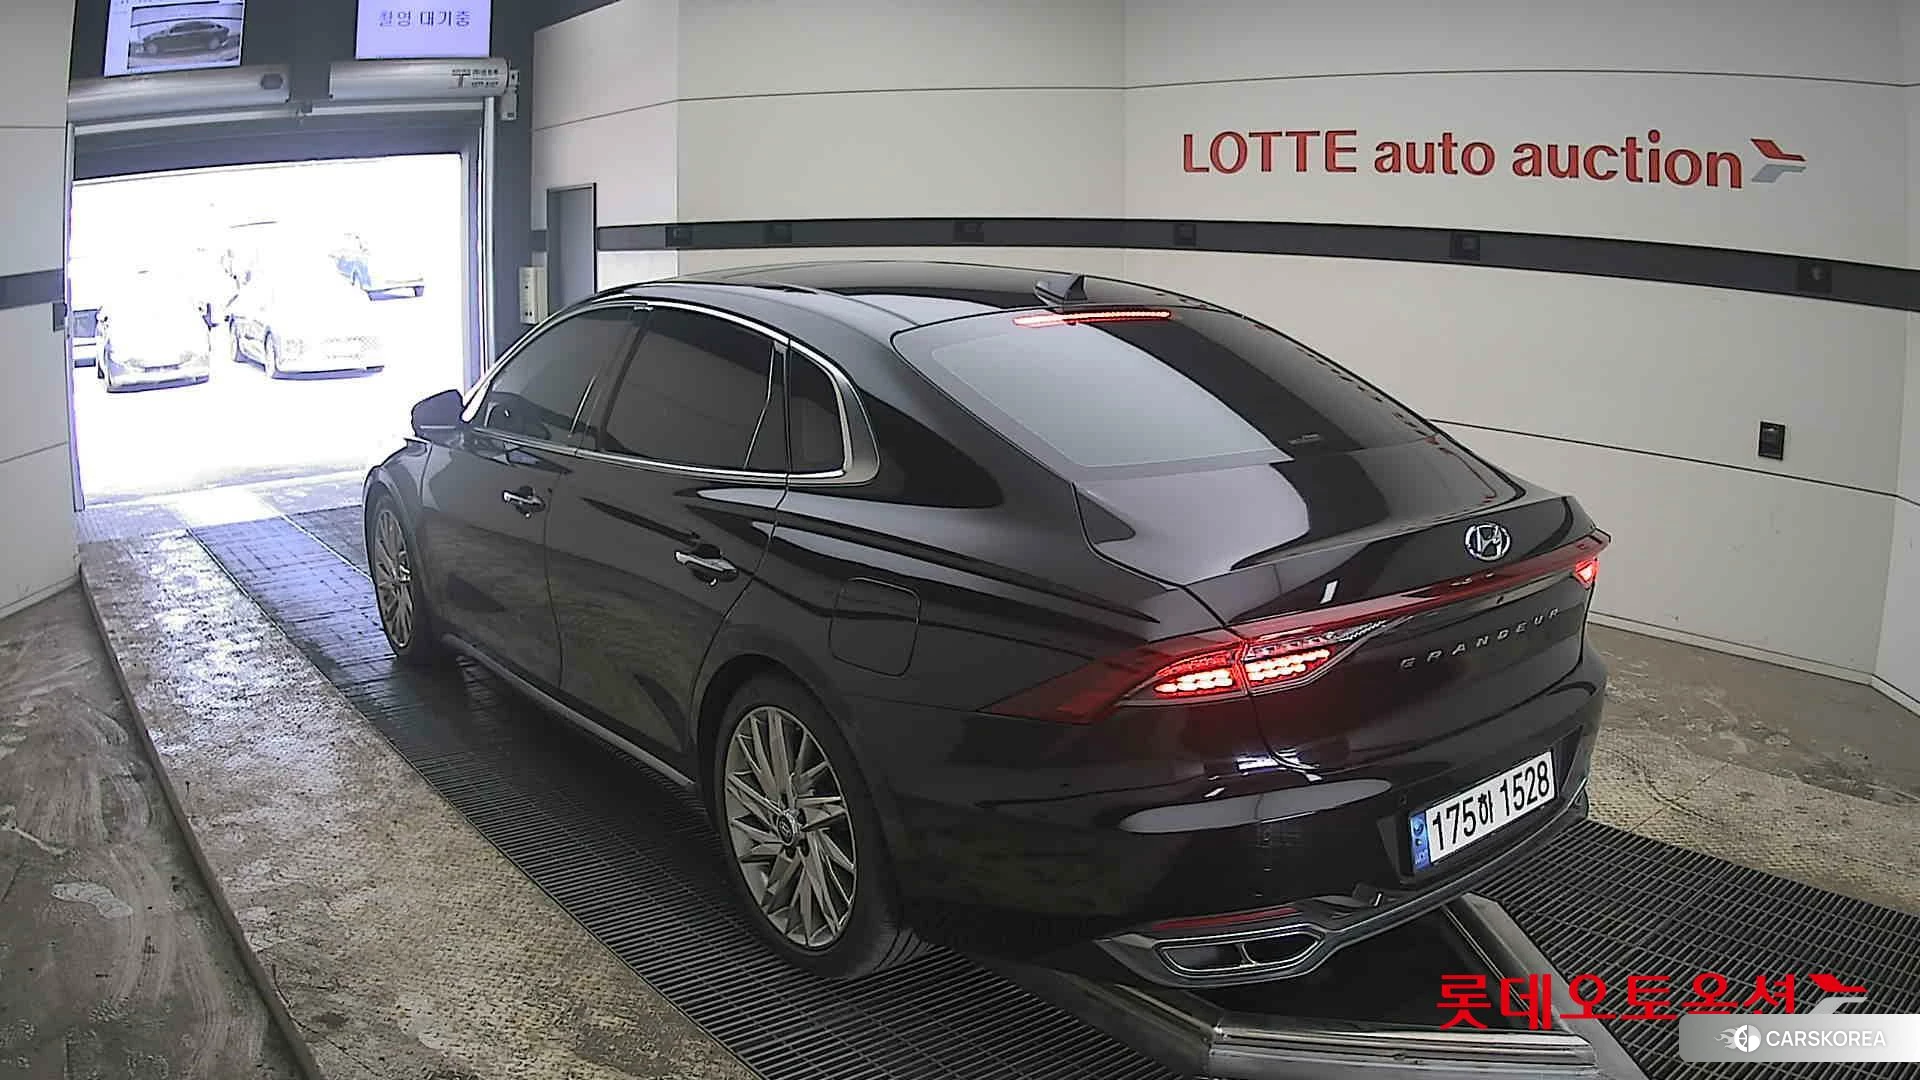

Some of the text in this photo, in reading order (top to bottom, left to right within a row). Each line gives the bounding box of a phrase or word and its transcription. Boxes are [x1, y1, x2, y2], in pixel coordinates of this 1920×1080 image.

[420, 10, 470, 27] 대기중
[1183, 129, 1742, 189] LOTTE auto auction
[1400, 608, 1559, 669] GRANDEUR
[1432, 761, 1550, 851] 175하 1528
